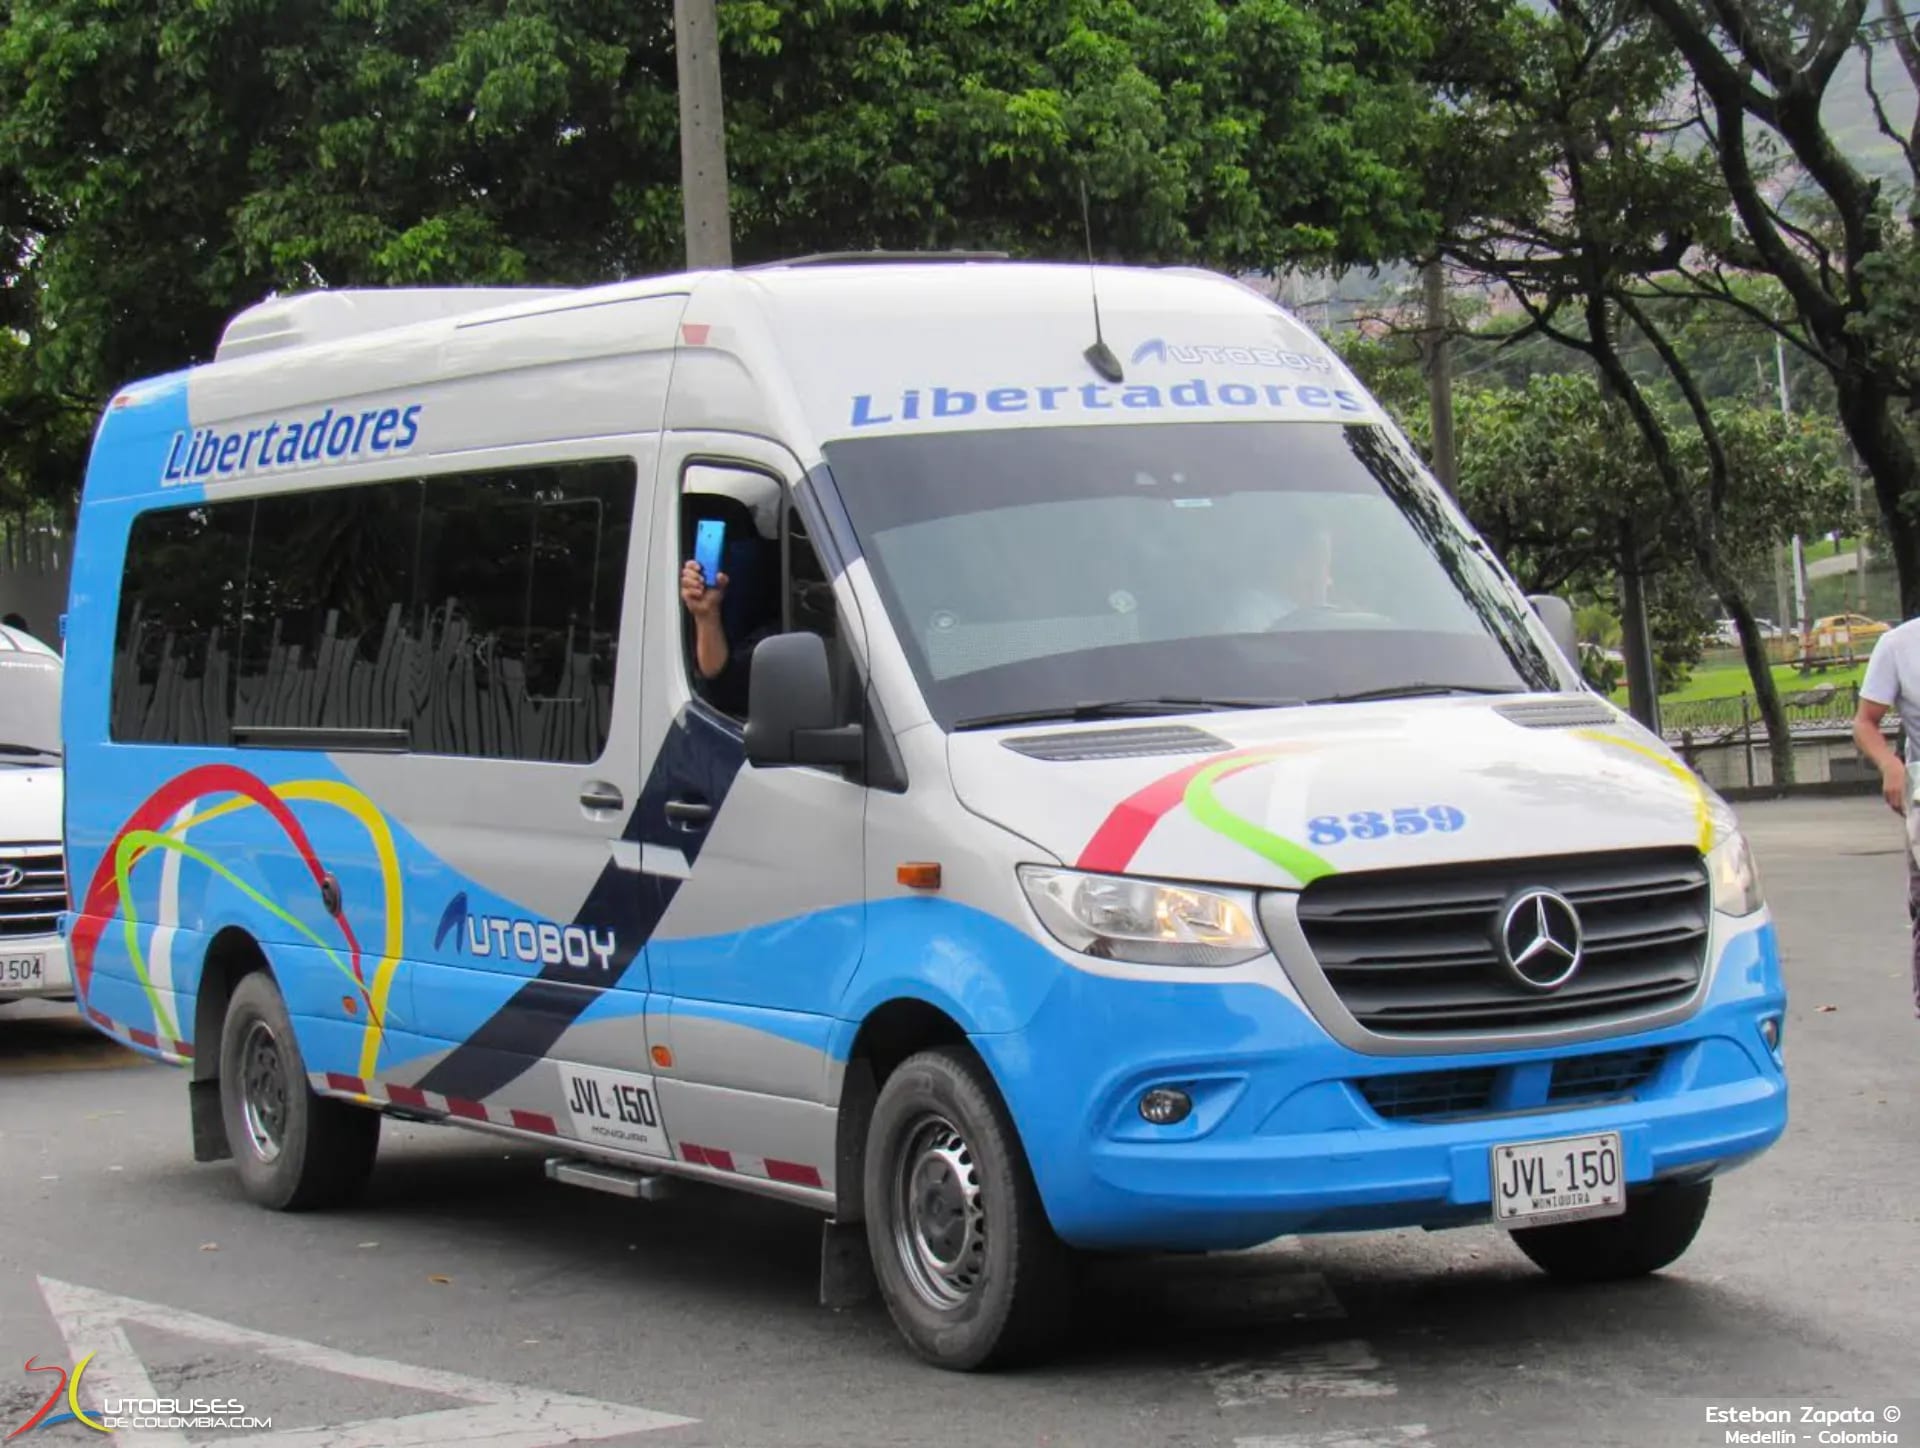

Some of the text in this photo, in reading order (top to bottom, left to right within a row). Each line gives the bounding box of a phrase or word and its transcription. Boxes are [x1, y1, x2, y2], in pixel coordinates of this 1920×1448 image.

[851, 379, 1367, 427] Libertadores
[162, 404, 423, 482] Libertadores
[1307, 804, 1465, 846] 8359
[434, 891, 616, 970] AUTOBOY
[9, 958, 41, 980] 504
[570, 1076, 657, 1128] JVL 150
[1502, 1148, 1616, 1198] JVL 150
